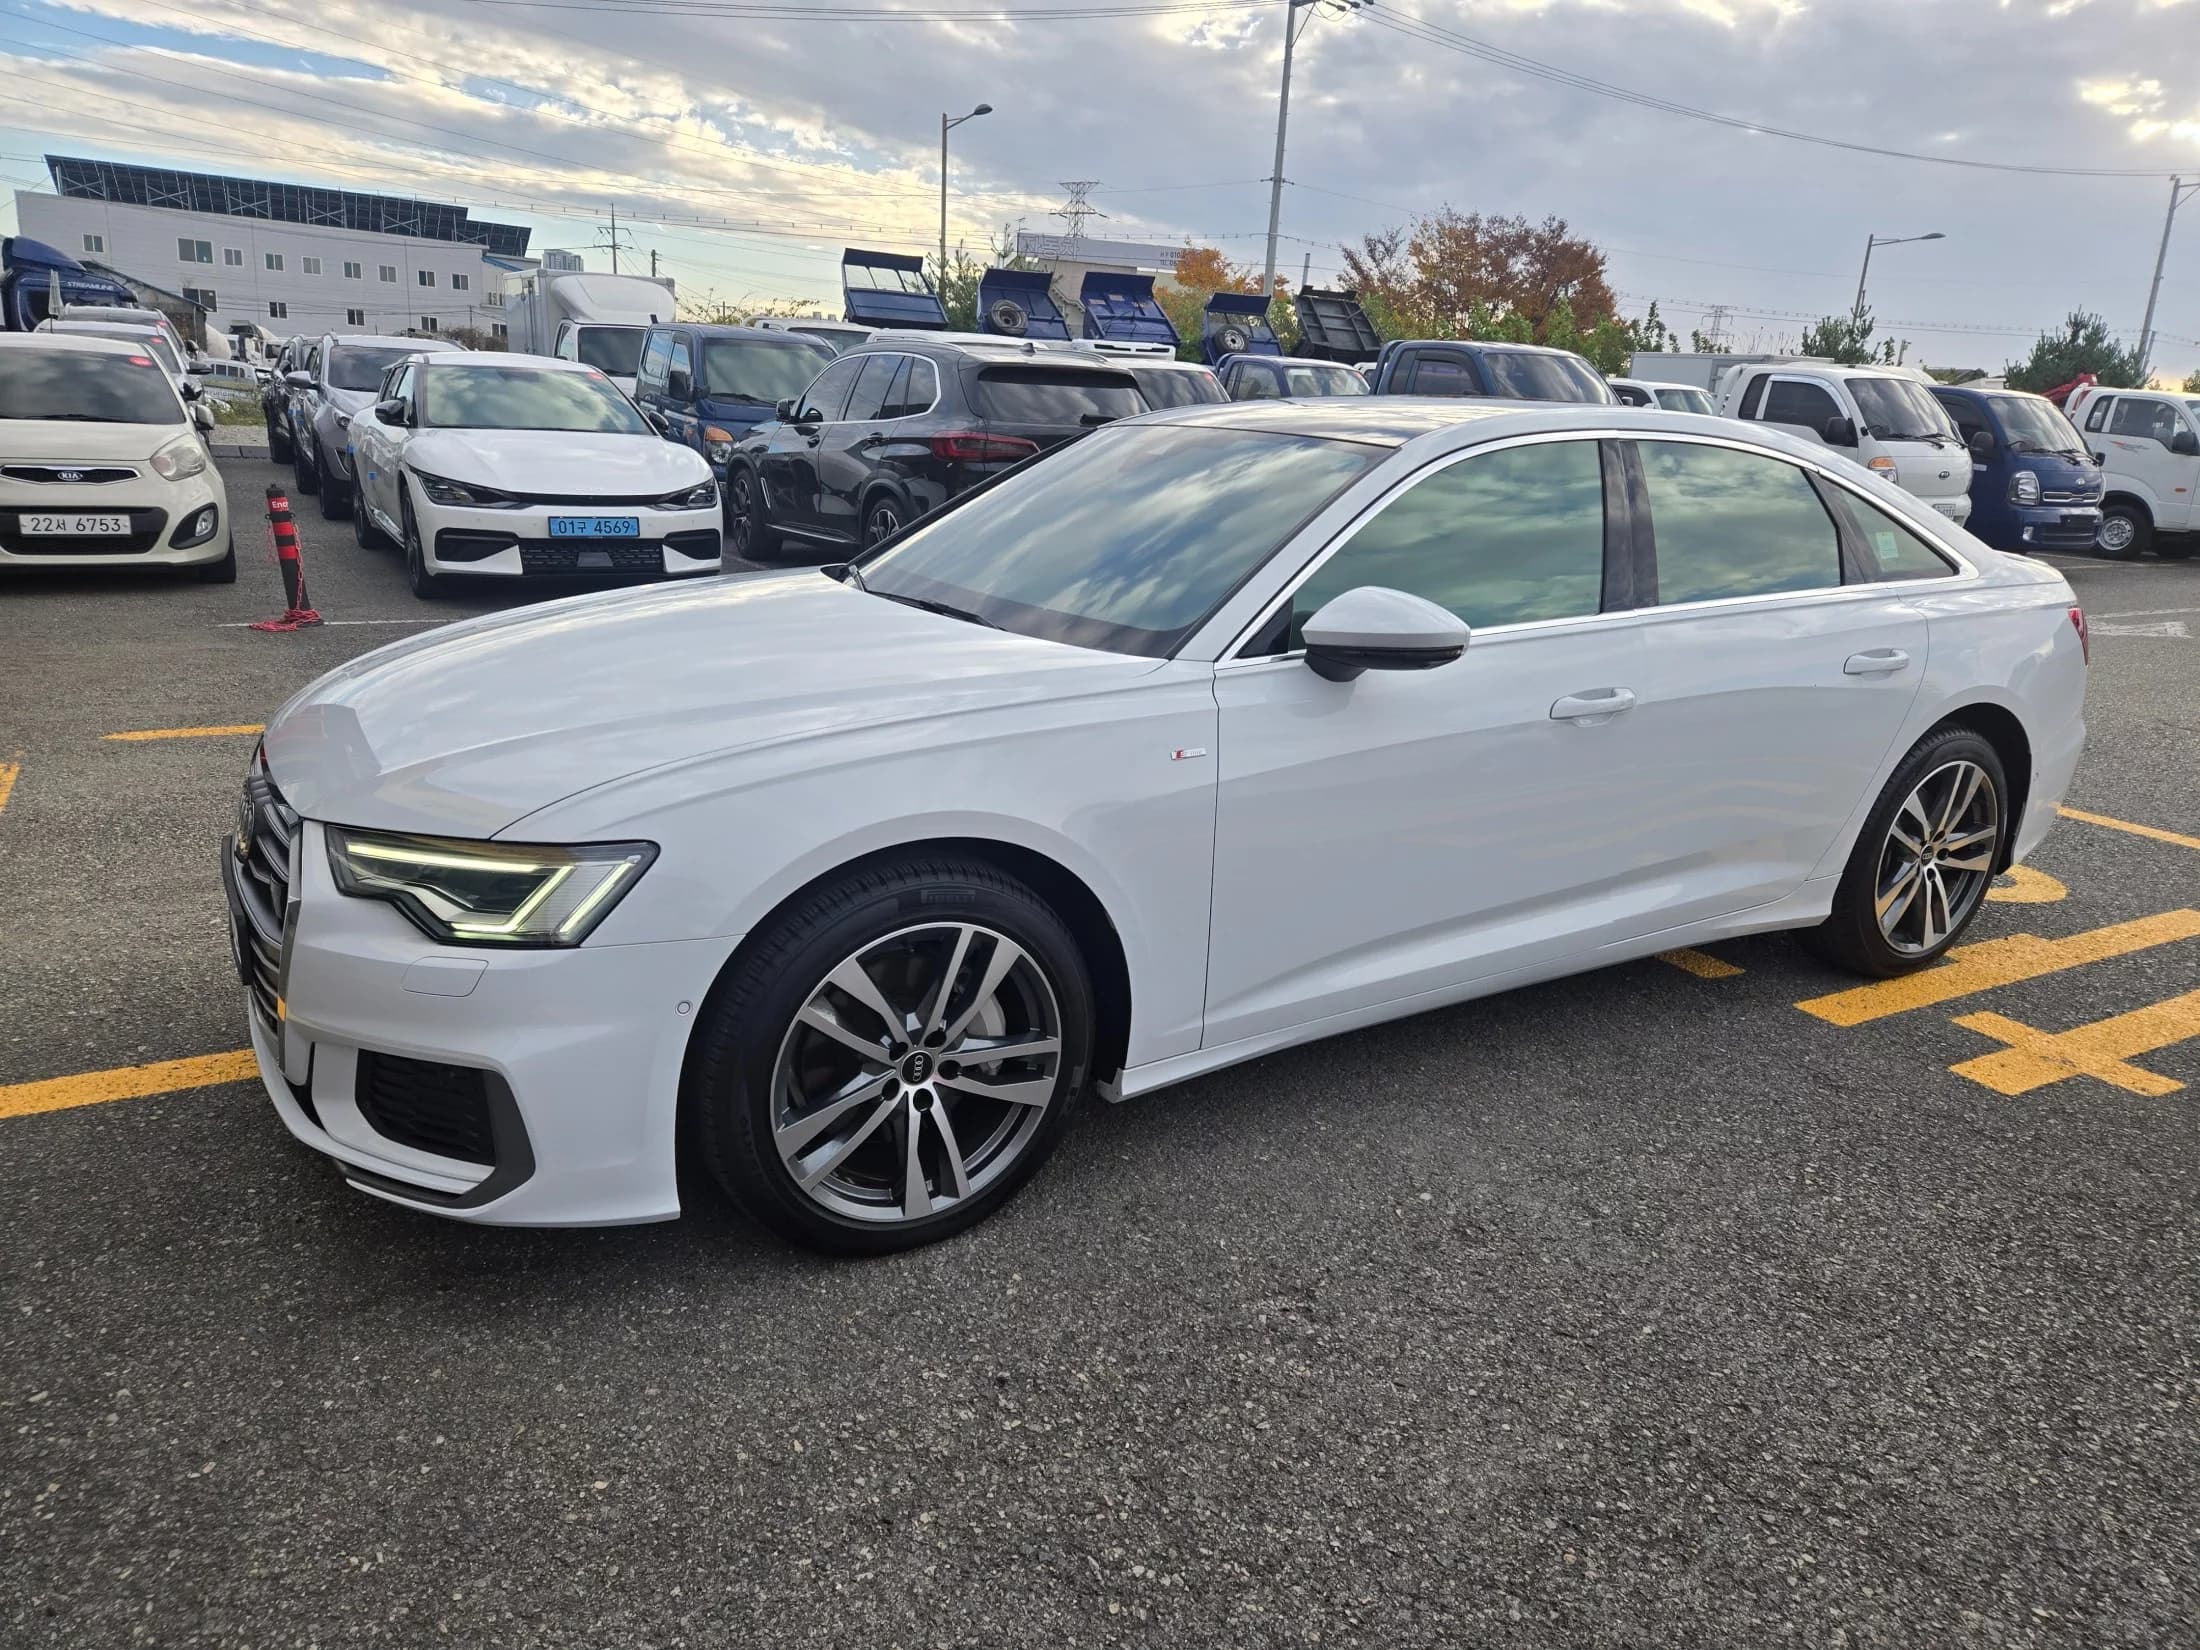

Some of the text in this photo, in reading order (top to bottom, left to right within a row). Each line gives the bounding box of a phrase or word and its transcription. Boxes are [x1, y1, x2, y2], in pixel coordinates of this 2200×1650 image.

[1020, 234, 1080, 260] 자동차
[67, 281, 114, 291] STREAMLINE
[61, 472, 79, 480] KIA
[31, 517, 121, 532] 22서 6753
[558, 520, 631, 534] 01구 4569
